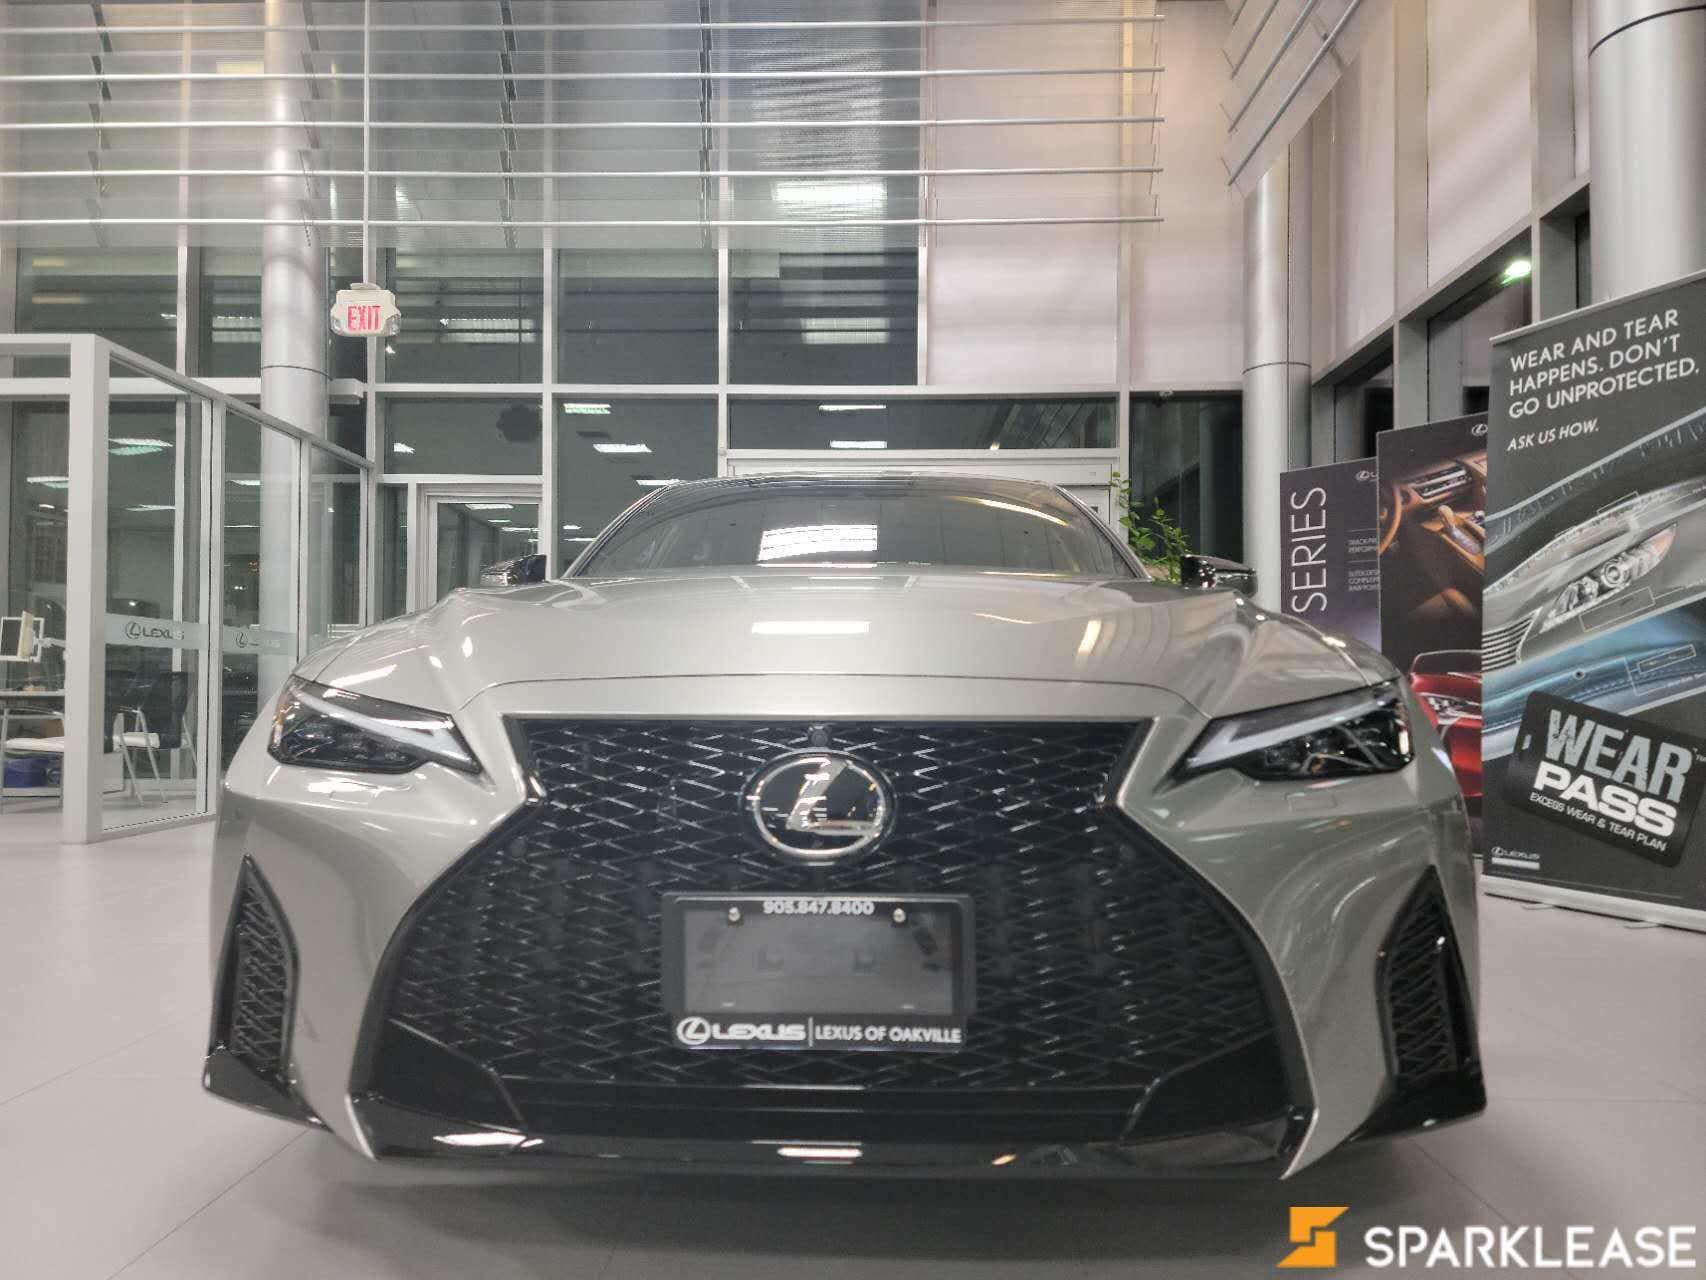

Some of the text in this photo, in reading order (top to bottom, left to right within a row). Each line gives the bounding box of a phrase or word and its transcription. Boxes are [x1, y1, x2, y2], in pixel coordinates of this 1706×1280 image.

[348, 305, 381, 331] EXIT
[1510, 308, 1679, 372] WEAR AND TEAR
[1508, 357, 1699, 419] GO UNPROTECTED.
[1509, 333, 1680, 396] HAPPENS. DON'T
[1507, 418, 1599, 451] ASK US HOW.
[1290, 487, 1328, 613] SERIES
[1545, 709, 1692, 803] WEAR
[1530, 791, 1667, 852] EXCESS WEAR & TEAR PLAN
[1533, 760, 1678, 837] PASS
[763, 897, 875, 915] 905.847.8400
[712, 1023, 806, 1041] LEXUS
[815, 1025, 961, 1043] LEXUS OF OAKVILLE
